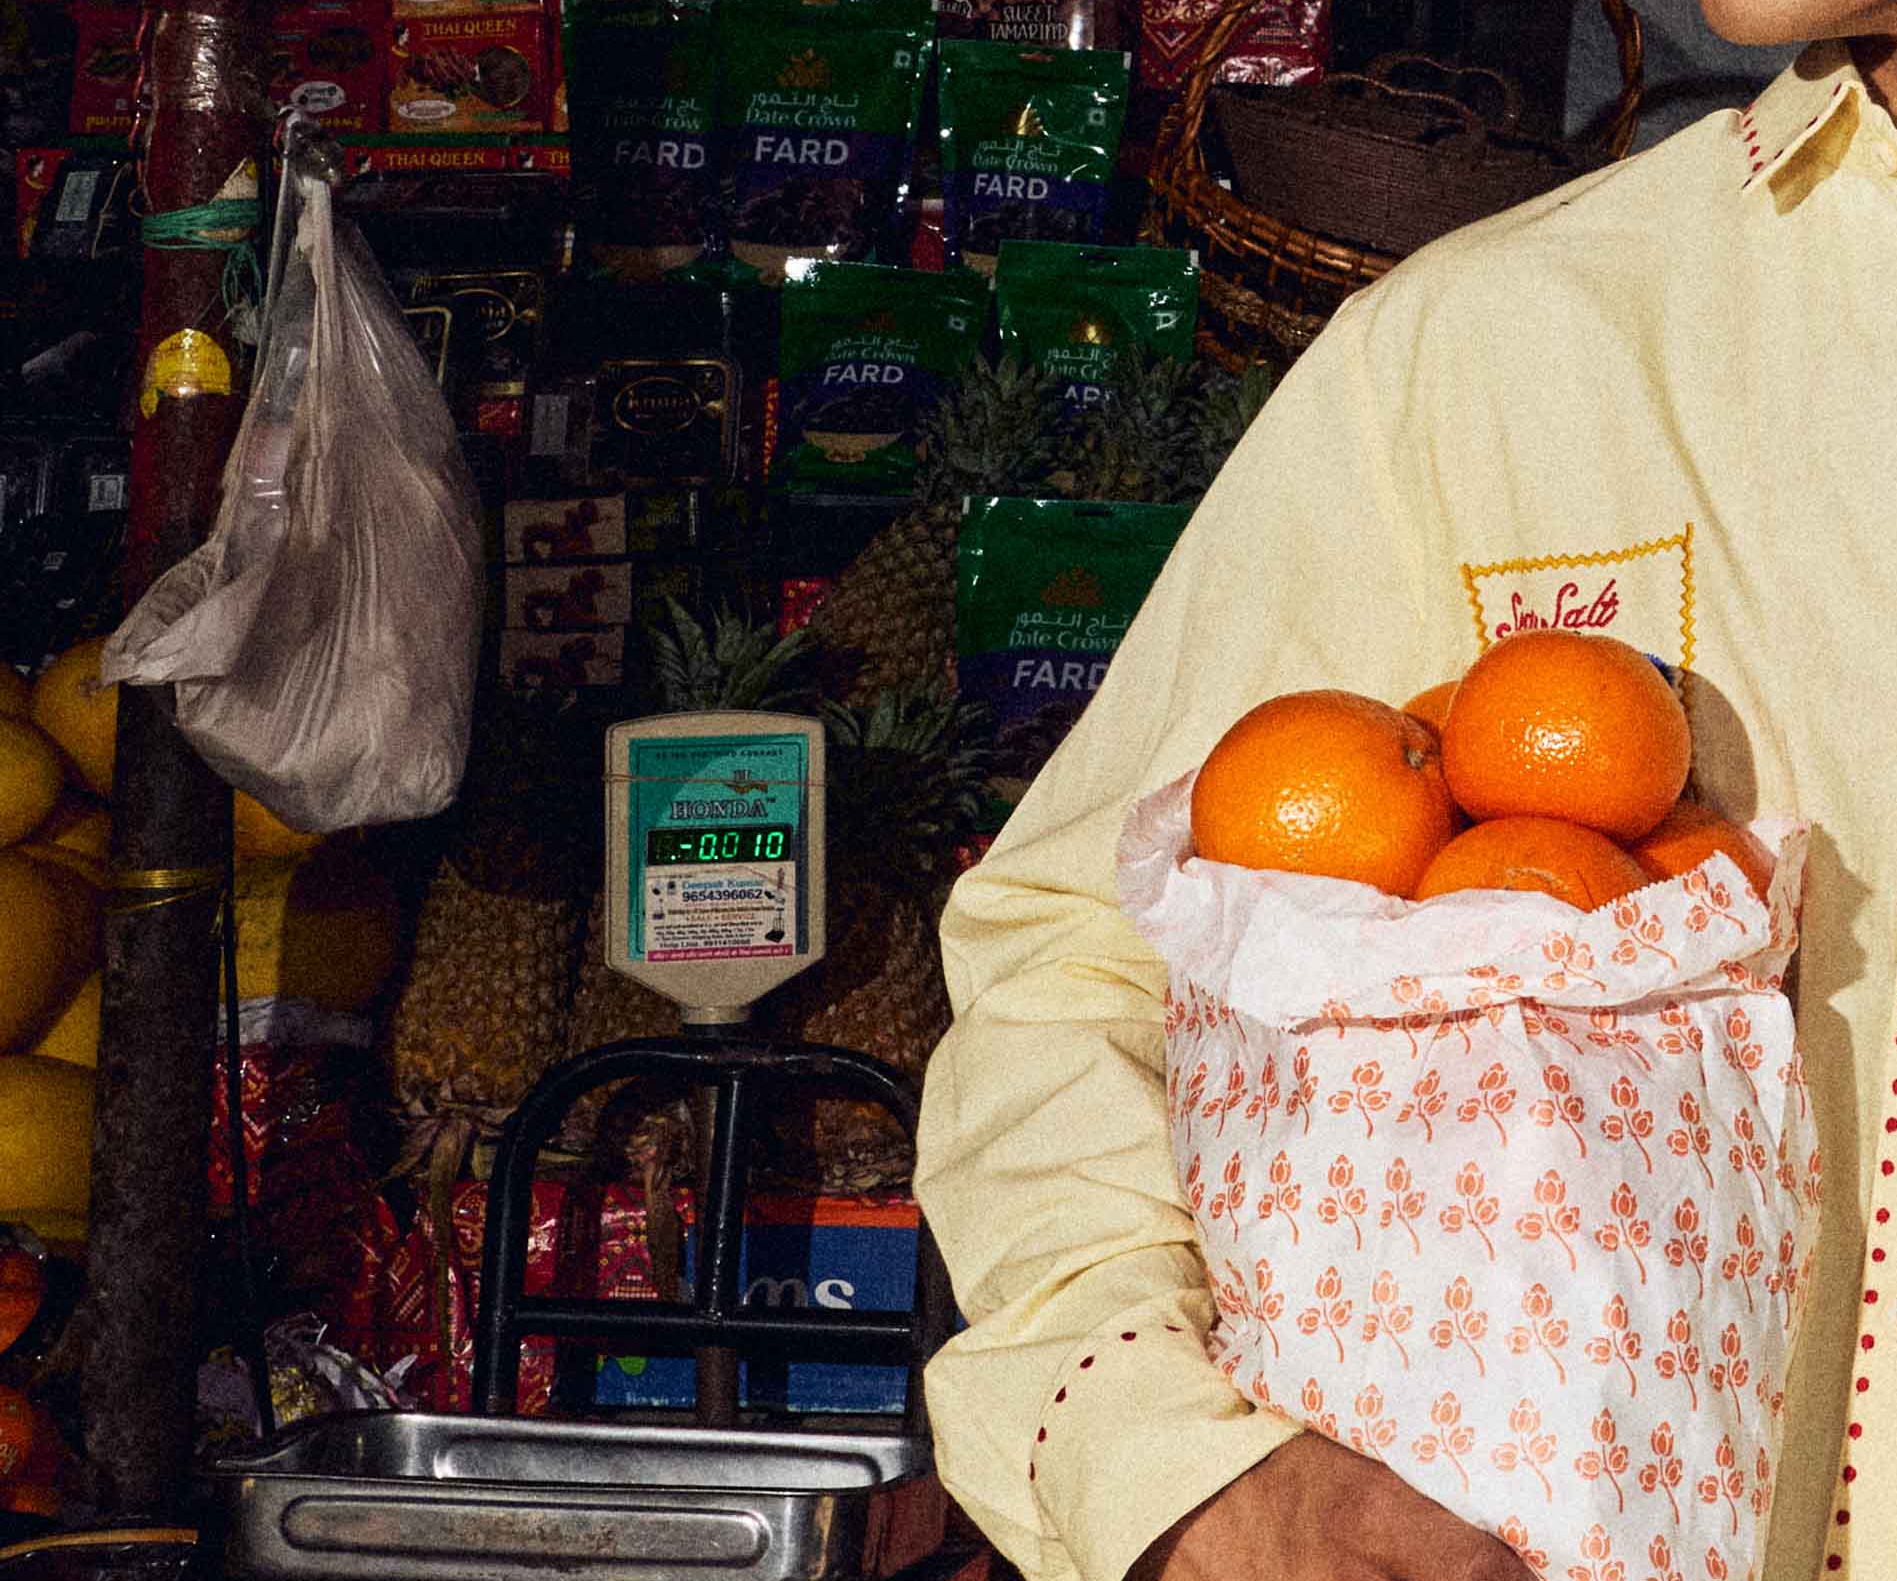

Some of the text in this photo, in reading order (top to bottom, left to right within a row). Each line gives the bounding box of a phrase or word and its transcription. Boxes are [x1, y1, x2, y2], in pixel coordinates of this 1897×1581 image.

[422, 19, 517, 36] THAI QUEEN
[990, 23, 1069, 40] TAMARIND
[746, 107, 856, 128] Date Crown
[386, 151, 487, 167] THAI QUEEN
[549, 150, 571, 164] TH
[613, 139, 706, 171] FARD
[754, 134, 850, 167] FARD
[1005, 154, 1059, 173] Crown
[972, 172, 1050, 202] FARD
[823, 363, 906, 387] FARD
[1008, 628, 1053, 648] Date
[1012, 658, 1109, 691] FARD
[671, 798, 768, 820] HONDA
